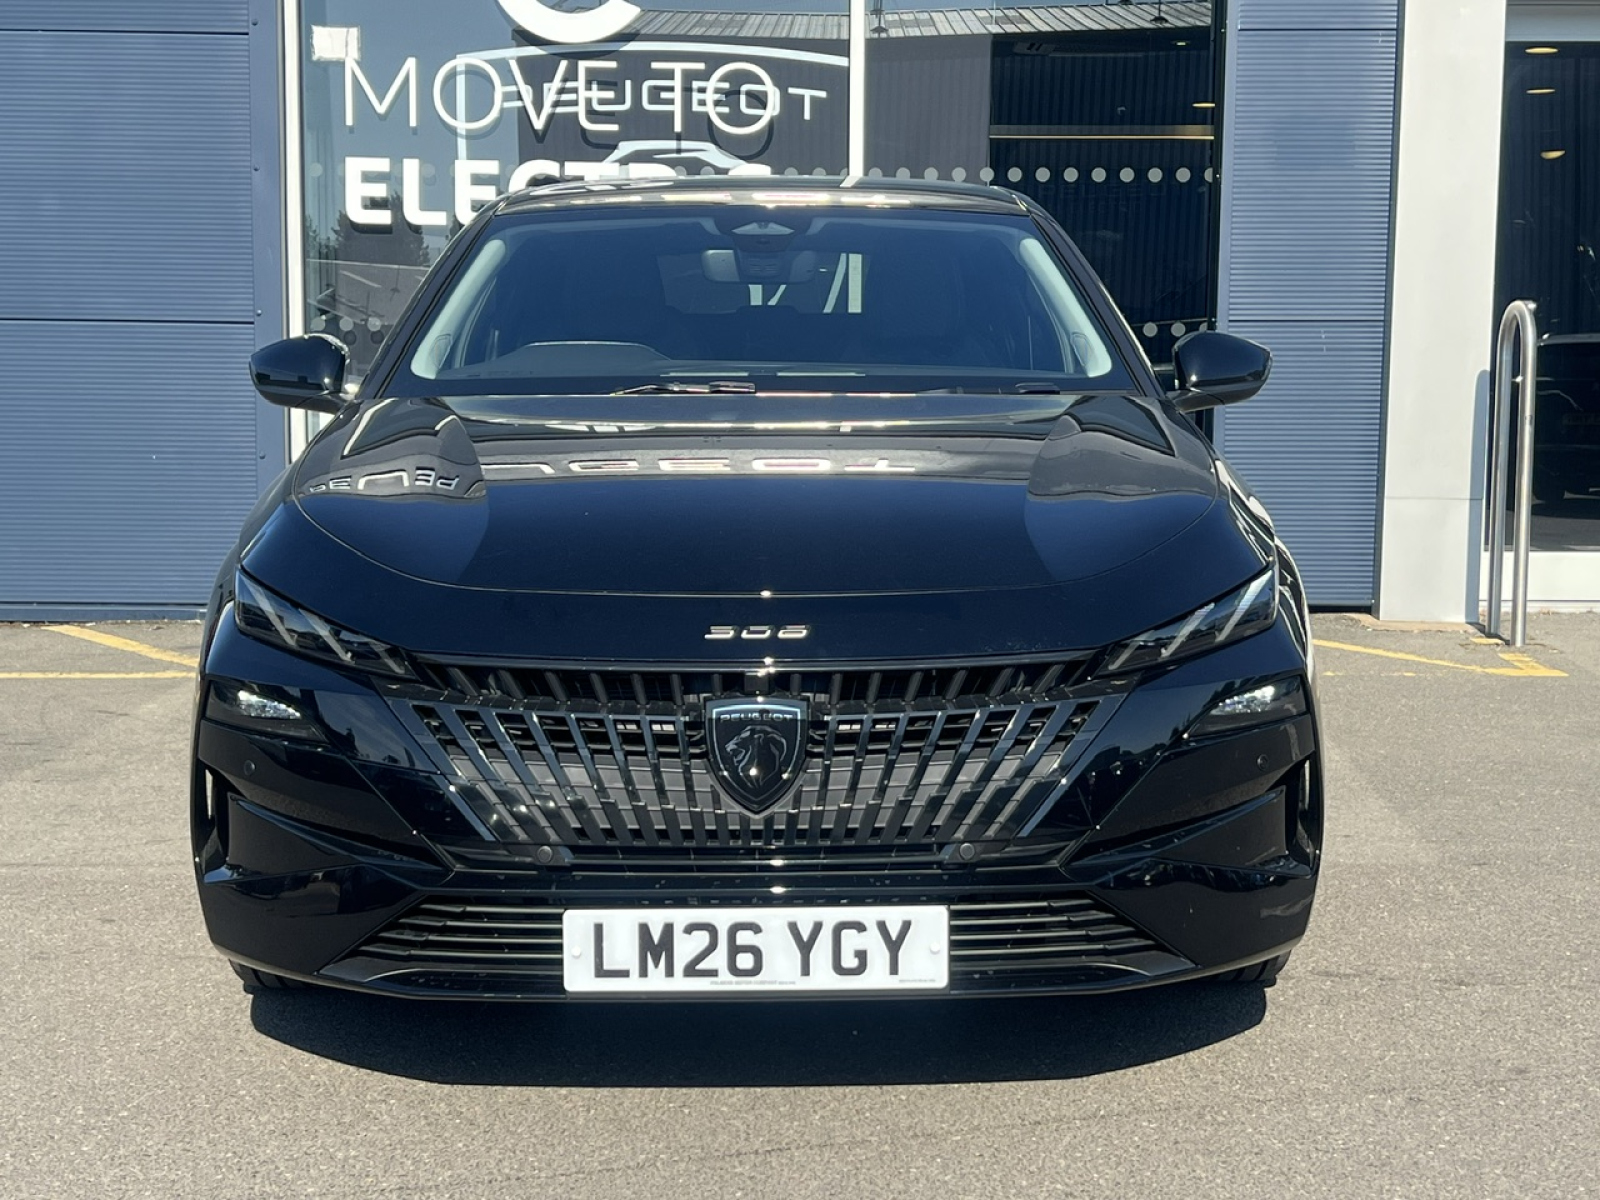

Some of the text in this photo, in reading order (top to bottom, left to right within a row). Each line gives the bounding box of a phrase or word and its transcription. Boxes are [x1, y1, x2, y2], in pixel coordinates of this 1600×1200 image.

[344, 56, 776, 135] MOVE TO
[719, 712, 794, 723] PEUGEOT
[593, 919, 912, 979] LM26 YGY
